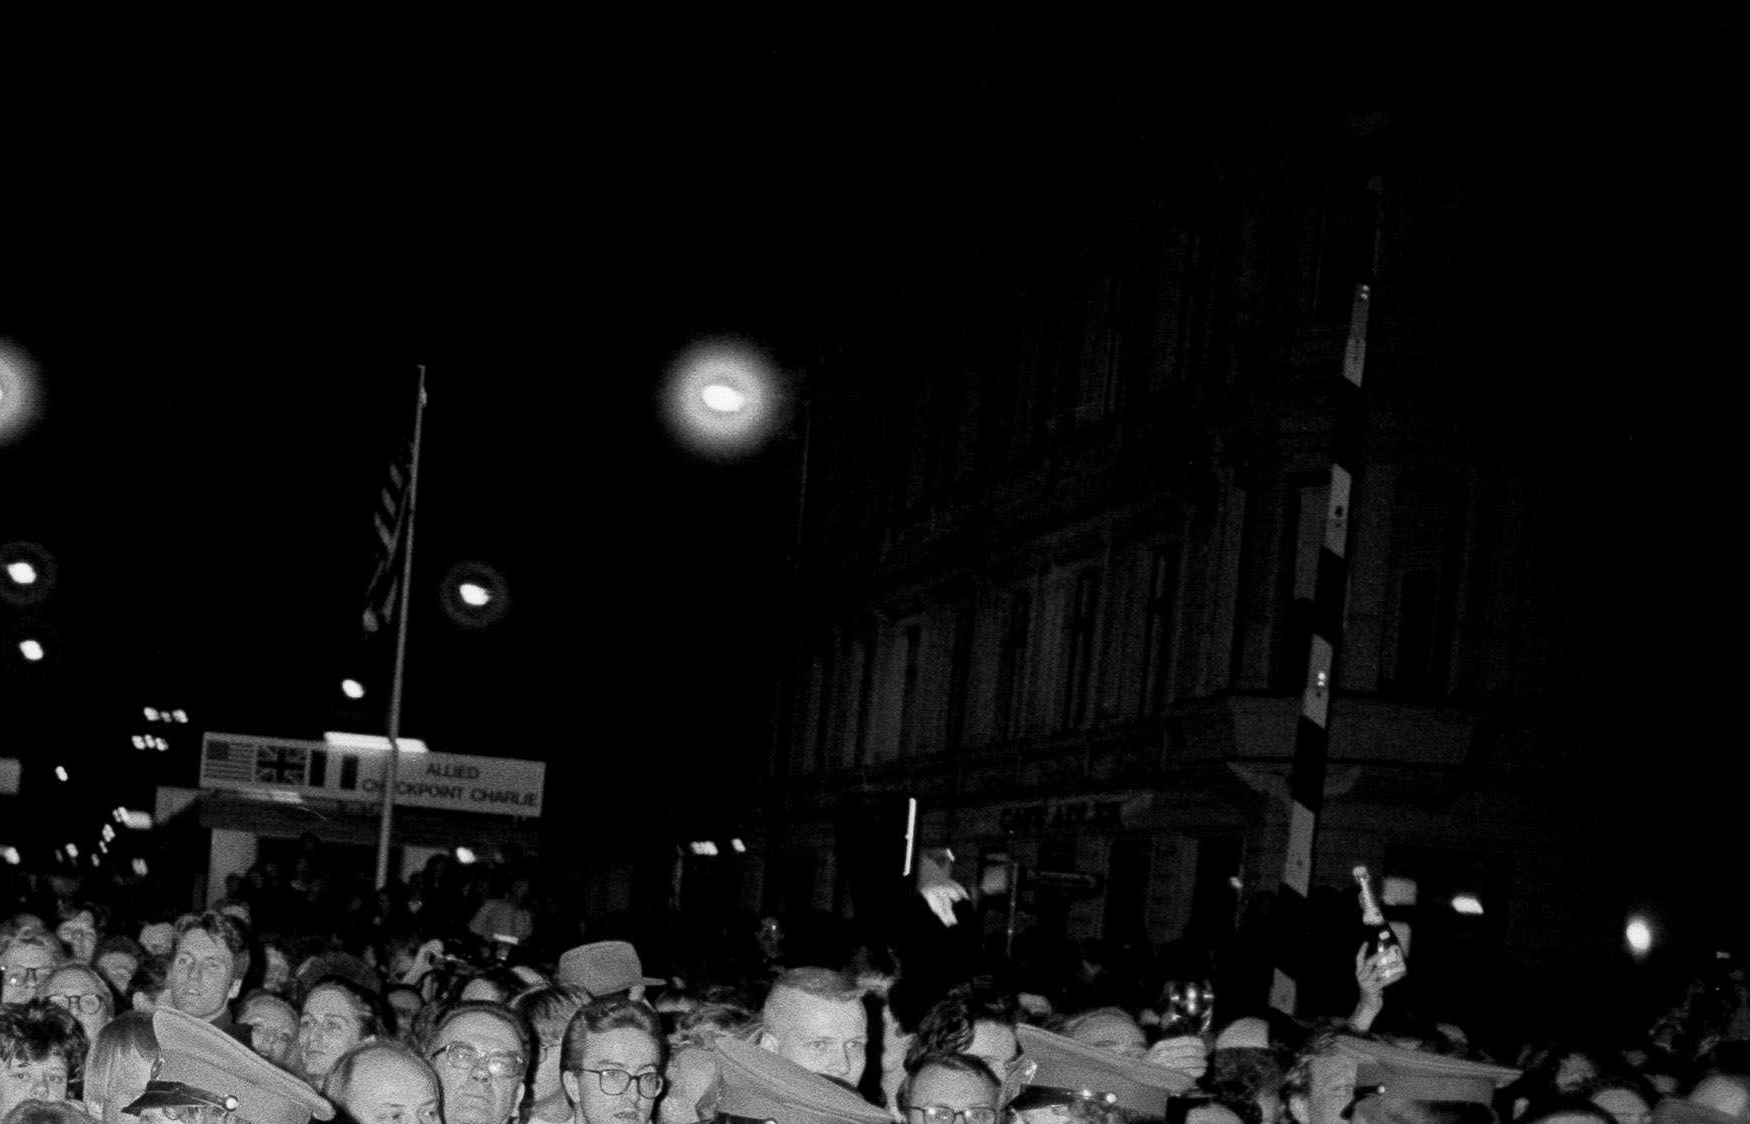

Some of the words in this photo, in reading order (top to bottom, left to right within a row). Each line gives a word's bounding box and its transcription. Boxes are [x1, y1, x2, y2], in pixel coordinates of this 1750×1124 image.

[426, 762, 480, 780] ALLIED
[362, 778, 464, 800] CHCKPOINT
[469, 787, 538, 807] CHARLIE
